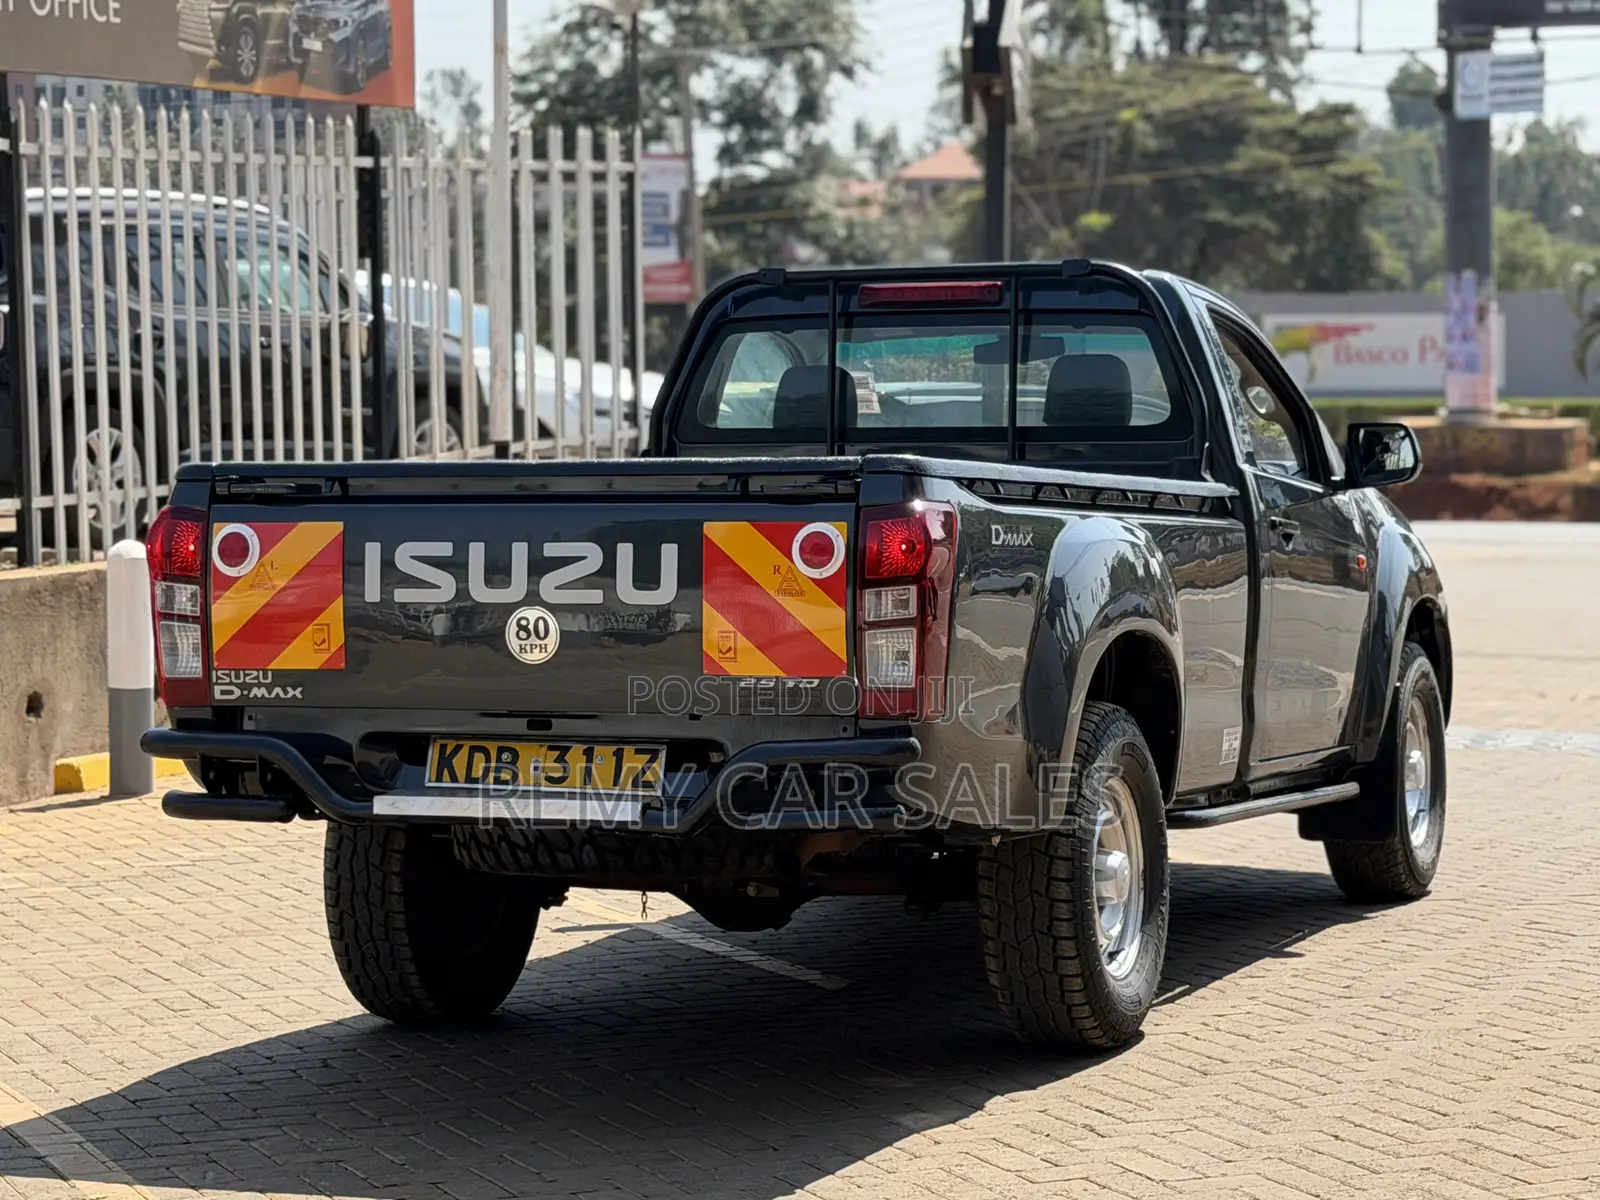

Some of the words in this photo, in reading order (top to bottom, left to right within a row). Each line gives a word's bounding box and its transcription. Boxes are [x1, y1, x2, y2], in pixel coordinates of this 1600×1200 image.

[364, 541, 679, 605] ISUZU
[773, 565, 782, 575] R
[515, 616, 550, 641] 80
[518, 643, 549, 655] KPH
[212, 670, 273, 684] ISUZU
[435, 743, 520, 785] KDB
[544, 745, 660, 788] 311Z
